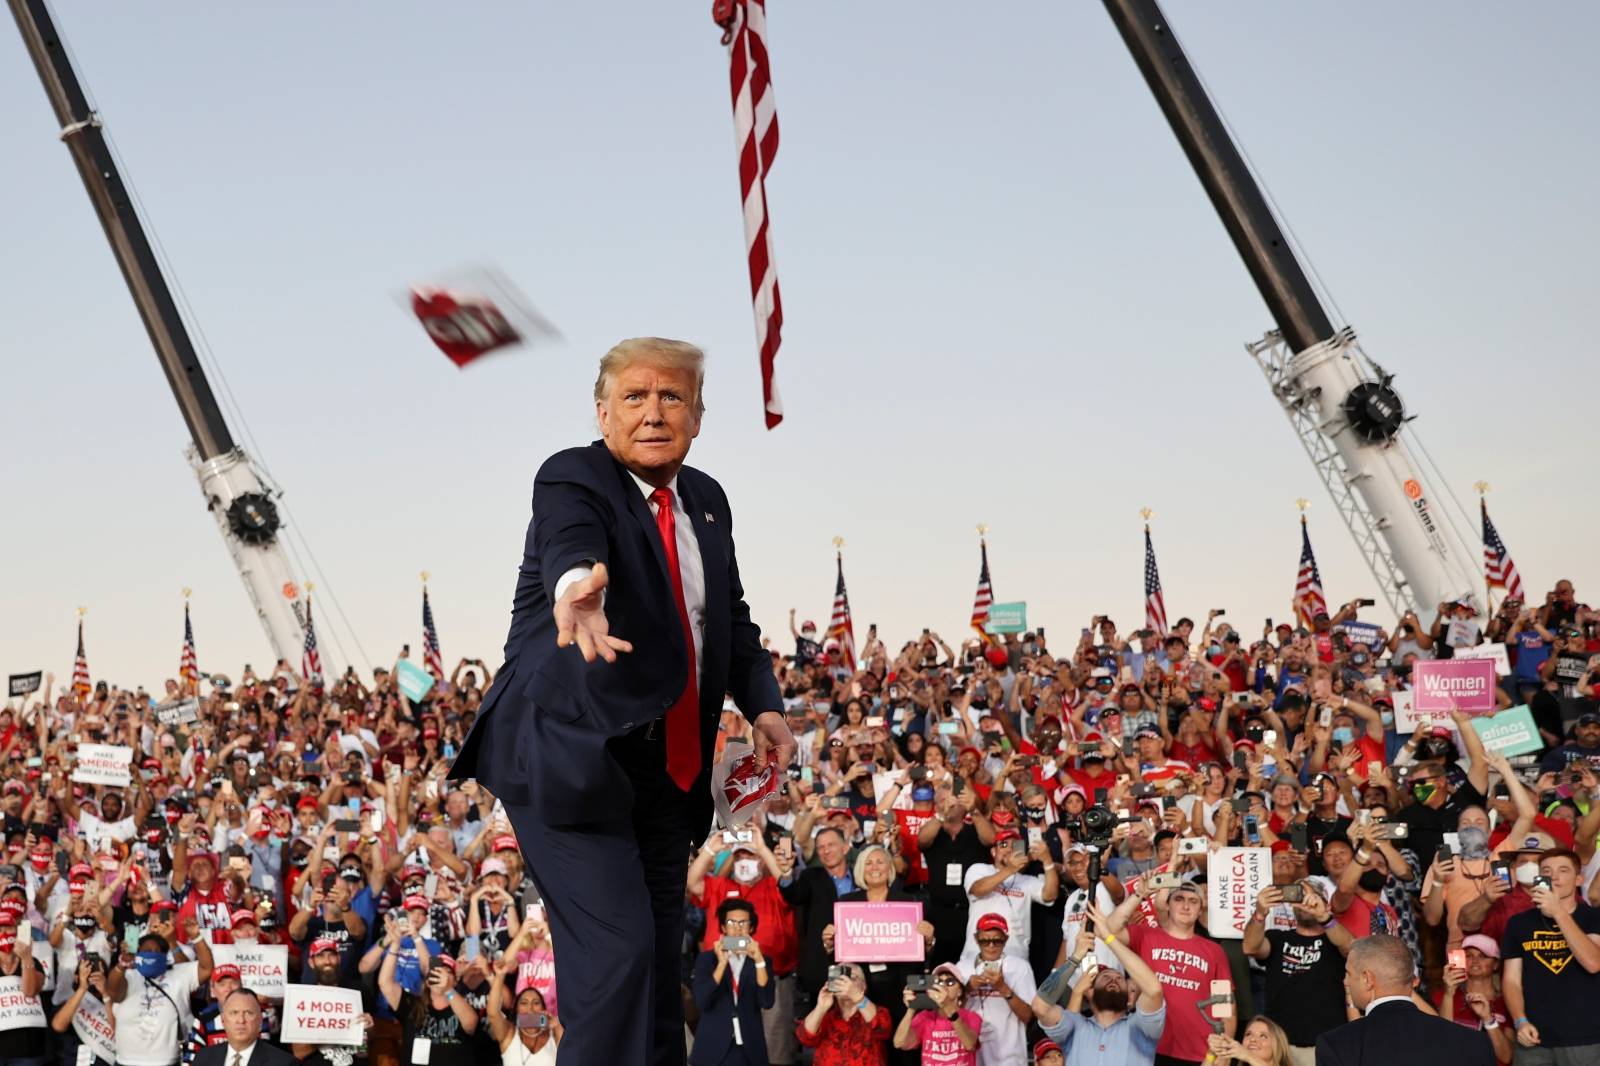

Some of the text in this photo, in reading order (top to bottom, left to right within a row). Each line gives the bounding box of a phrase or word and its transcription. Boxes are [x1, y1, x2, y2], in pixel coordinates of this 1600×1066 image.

[1413, 498, 1436, 533] Sims
[290, 600, 307, 631] Sim
[1424, 674, 1485, 690] Women
[1430, 689, 1480, 698] FOR TRUMP
[1481, 721, 1526, 741] atinos
[79, 759, 129, 771] AMERICA
[1248, 852, 1259, 890] AGAIN
[1219, 875, 1229, 909] MAKE
[1231, 852, 1246, 932] AMERICA
[845, 918, 912, 937] Women
[852, 936, 906, 945] FOR TRUMP
[1522, 940, 1569, 951] WOLVER
[236, 953, 264, 962] MAKE
[1152, 948, 1208, 974] WESTERN
[240, 965, 282, 976] ERICA
[0, 995, 40, 1007] ERICA
[296, 1001, 353, 1014] 4 MORE
[16, 1008, 42, 1017] AGAIN
[297, 1017, 351, 1030] YEARS!
[100, 1040, 117, 1055] AGA
